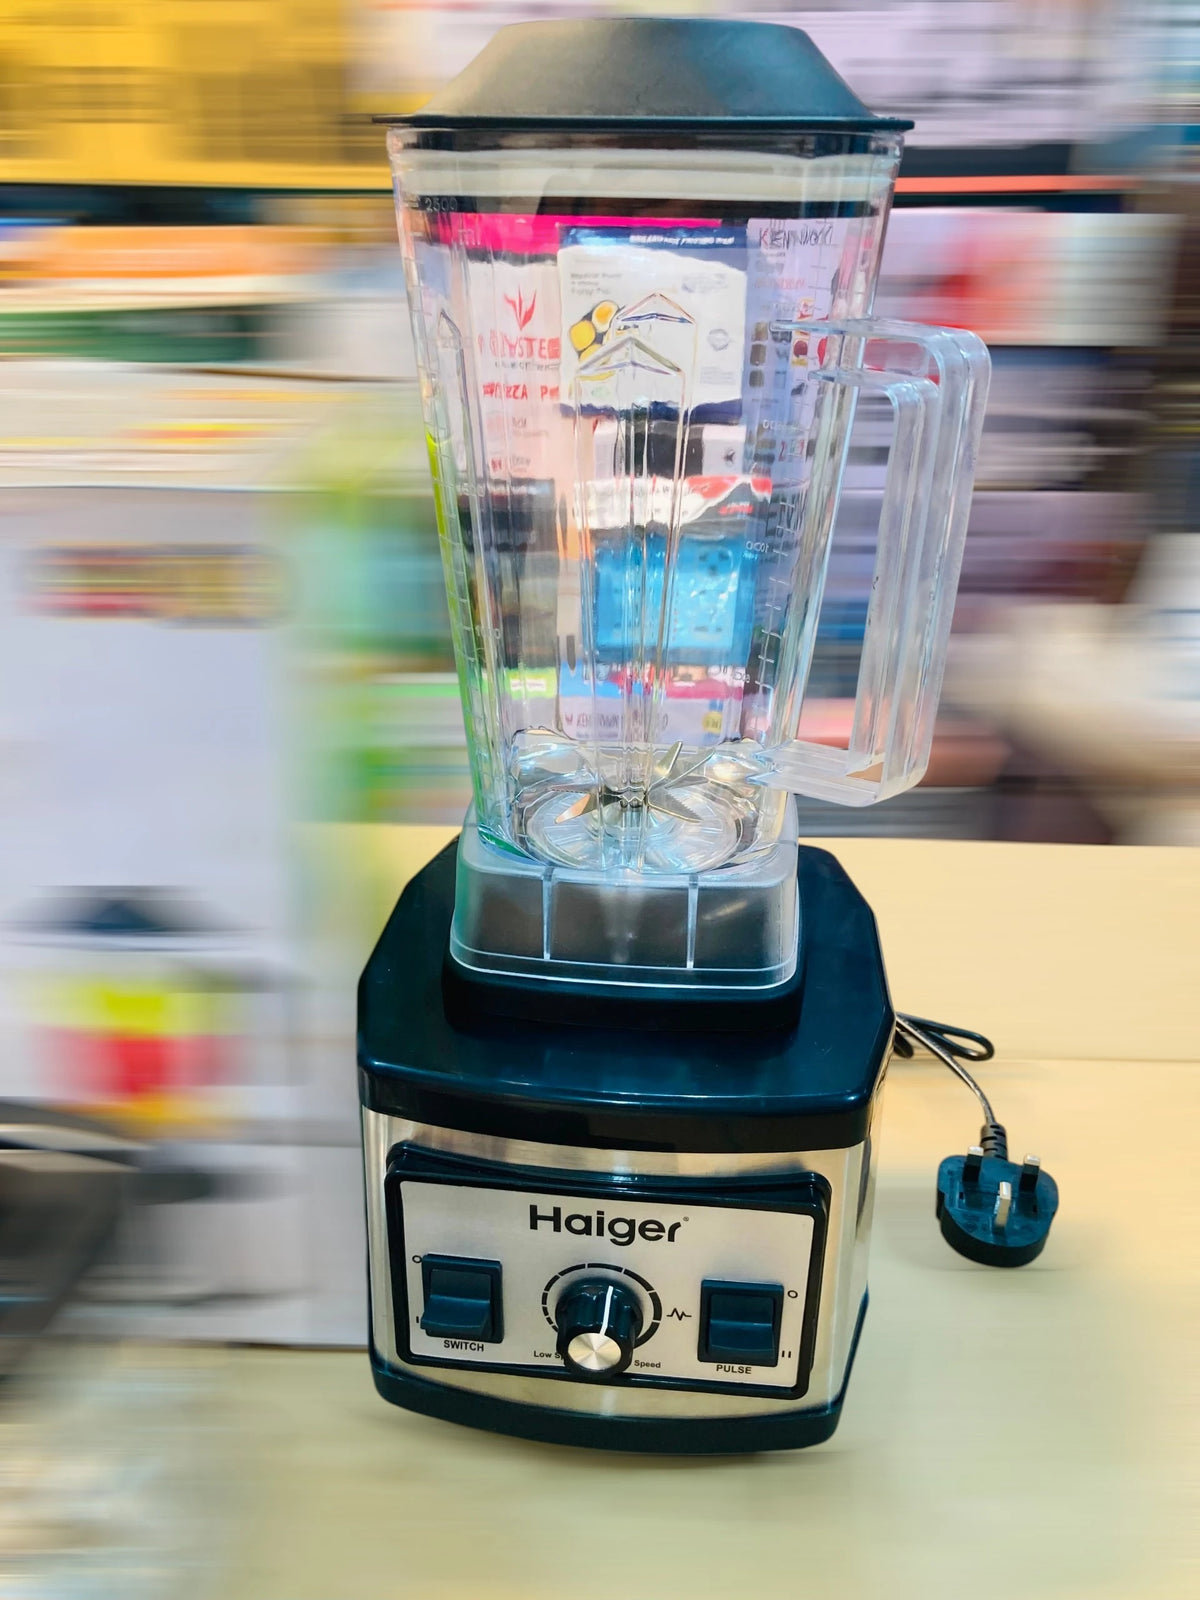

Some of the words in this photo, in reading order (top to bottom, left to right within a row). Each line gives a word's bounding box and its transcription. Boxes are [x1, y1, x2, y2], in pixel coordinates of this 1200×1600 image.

[529, 1204, 681, 1246] Haiger
[443, 1339, 485, 1352] SWITCH
[533, 1350, 553, 1359] Low
[633, 1359, 662, 1369] Speed
[716, 1364, 753, 1375] PULSE
